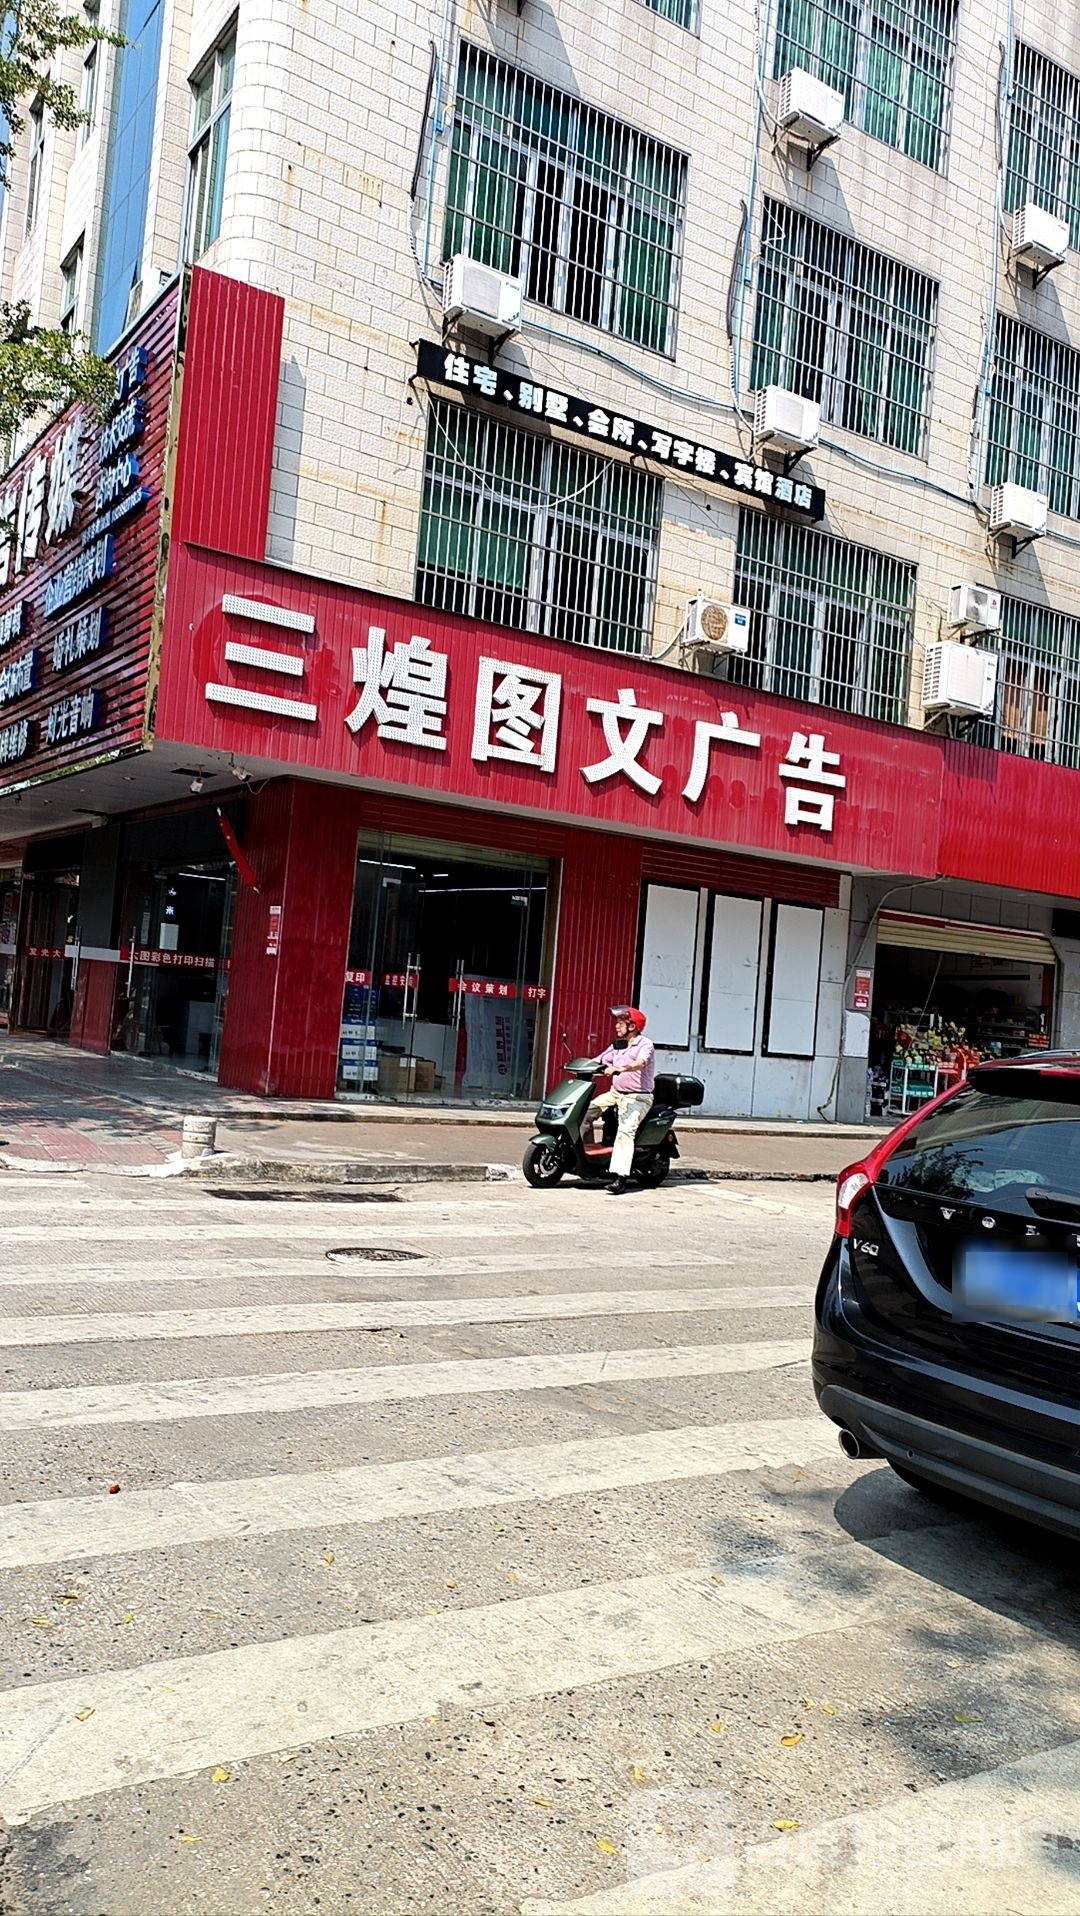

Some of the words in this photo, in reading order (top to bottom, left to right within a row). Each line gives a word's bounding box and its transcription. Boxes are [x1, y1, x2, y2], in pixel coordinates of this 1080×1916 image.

[443, 352, 813, 509] 住宅、别墅、会所、写字楼、宾馆酒店
[52, 606, 103, 672] 婚礼策划
[46, 688, 95, 745] 灯光音响
[205, 593, 846, 832] 三煌图文广告
[528, 987, 547, 999] 打字
[853, 1238, 880, 1257] V60
